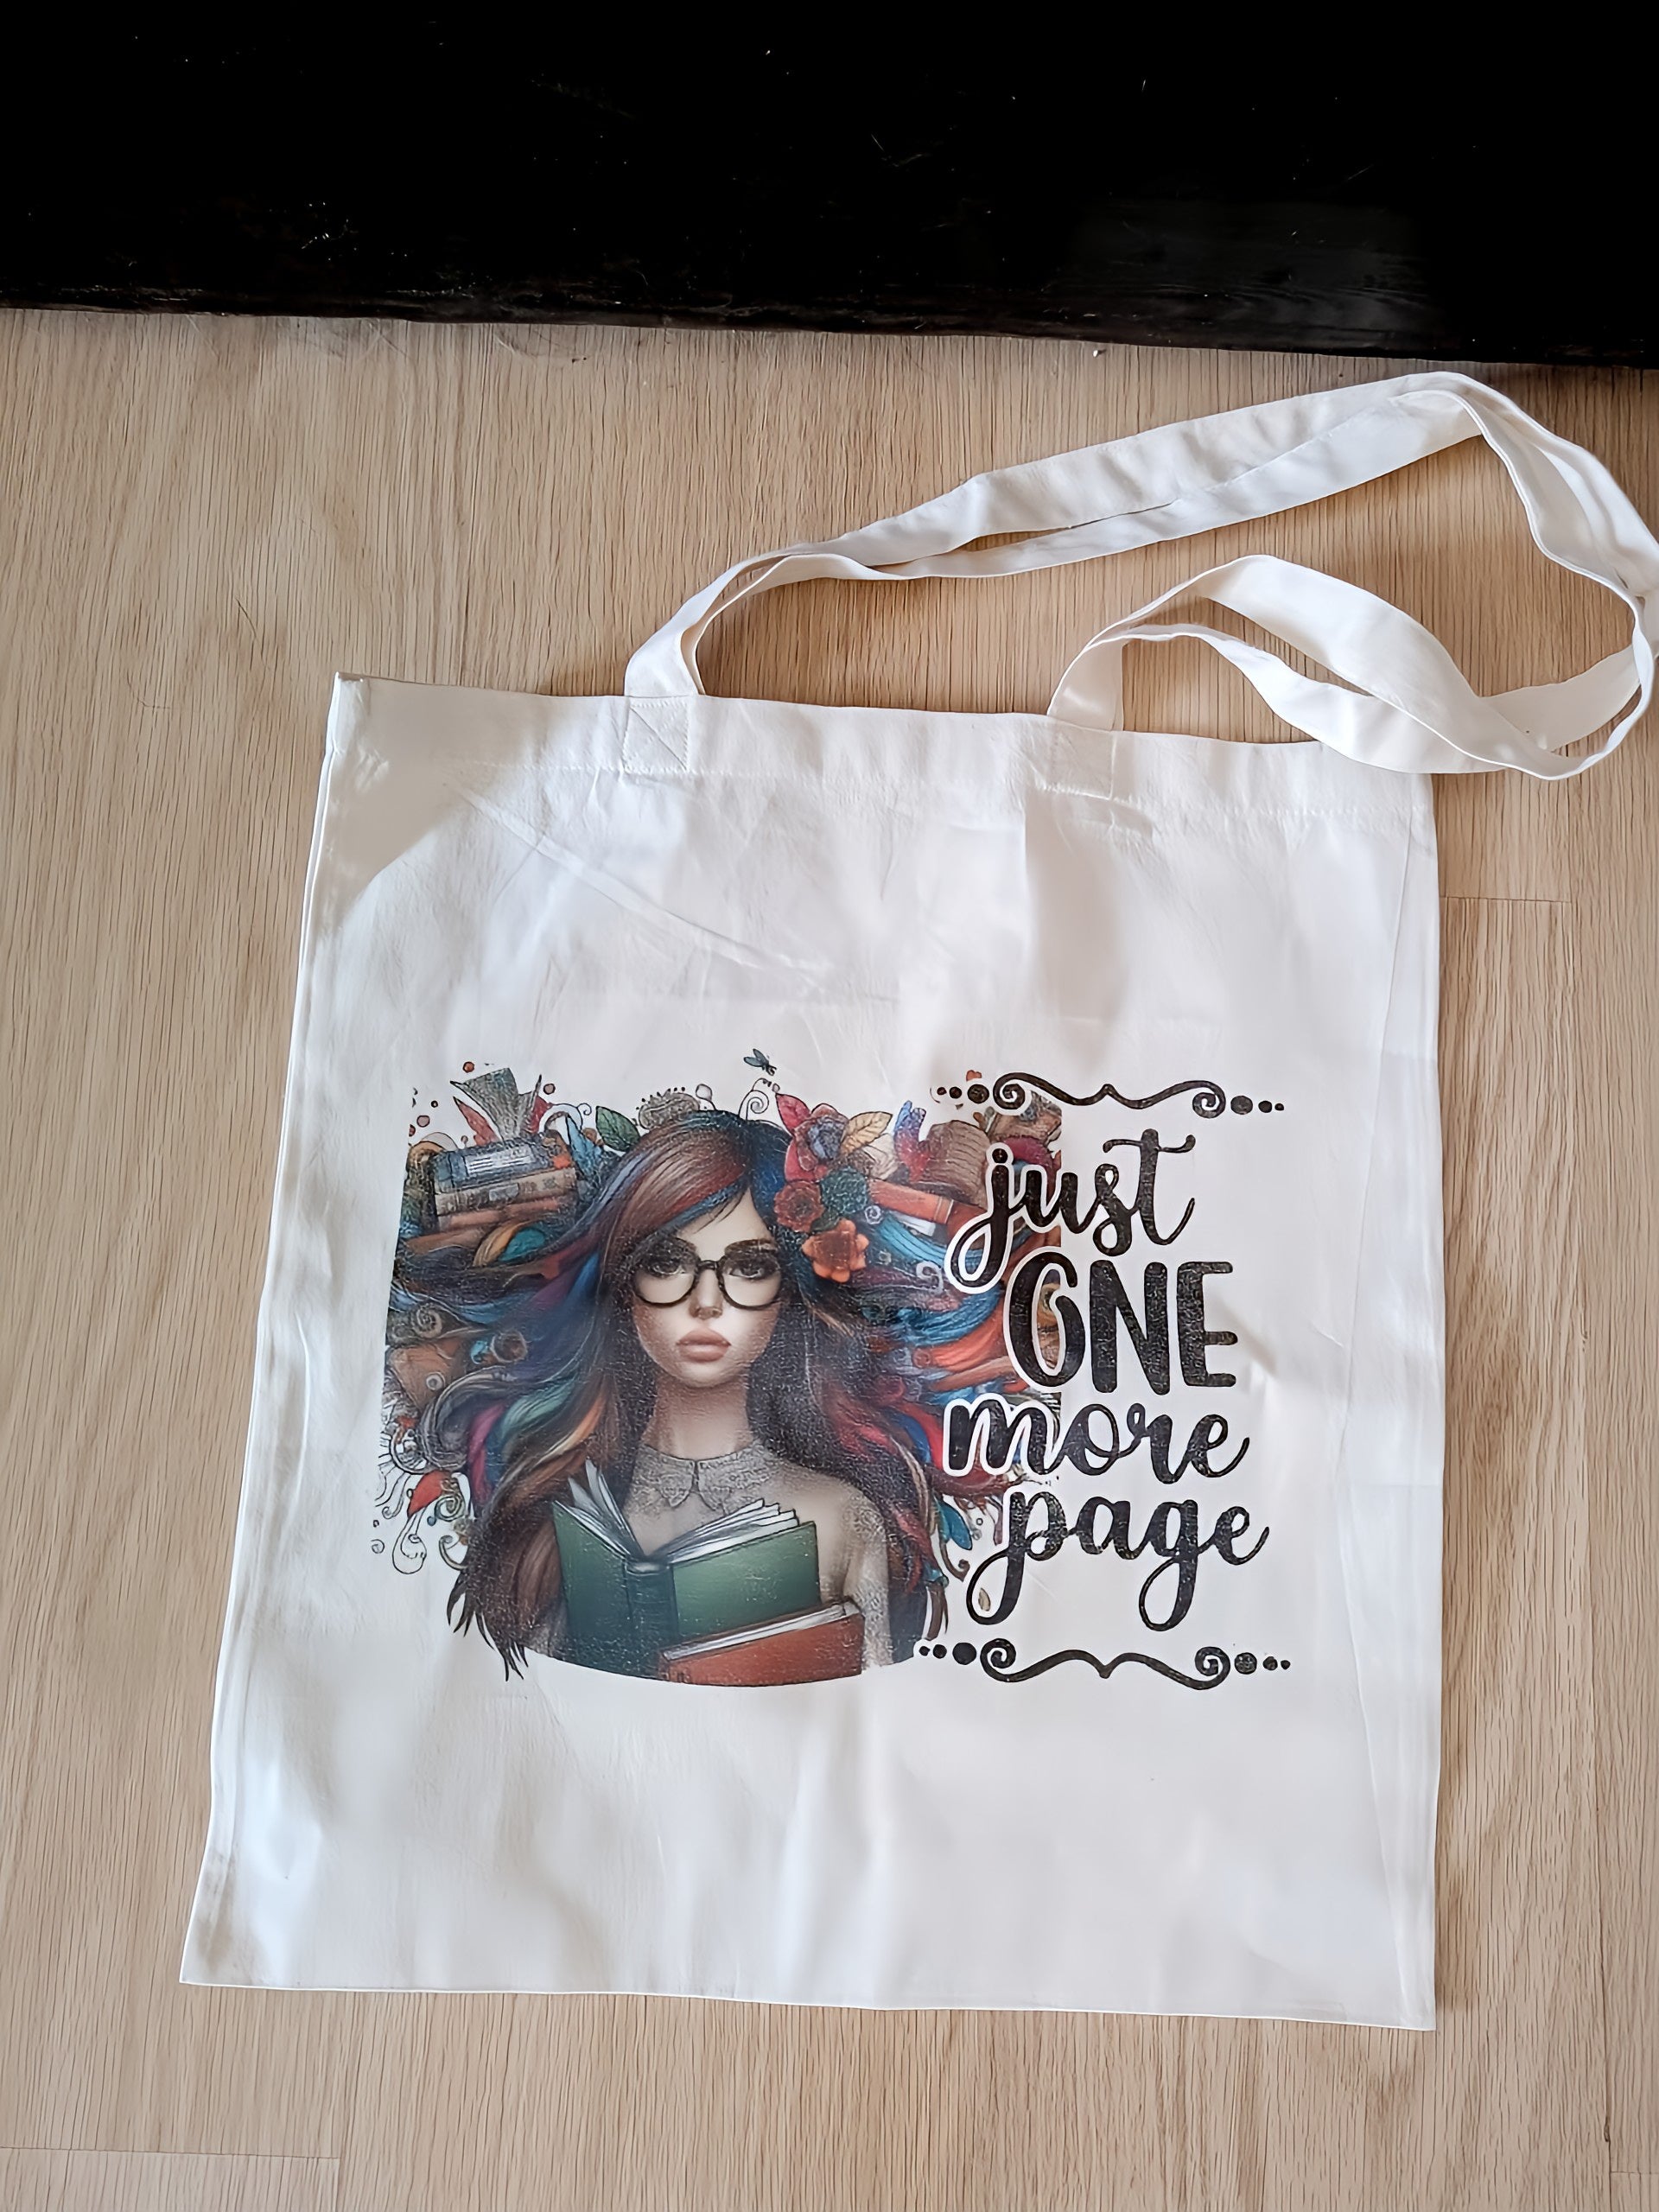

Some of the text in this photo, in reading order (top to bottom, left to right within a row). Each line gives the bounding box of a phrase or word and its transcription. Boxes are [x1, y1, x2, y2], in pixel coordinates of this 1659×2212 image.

[951, 1128, 1196, 1288] just
[1008, 1251, 1239, 1395] ONE
[948, 1397, 1250, 1484] more
[966, 1490, 1269, 1632] page
